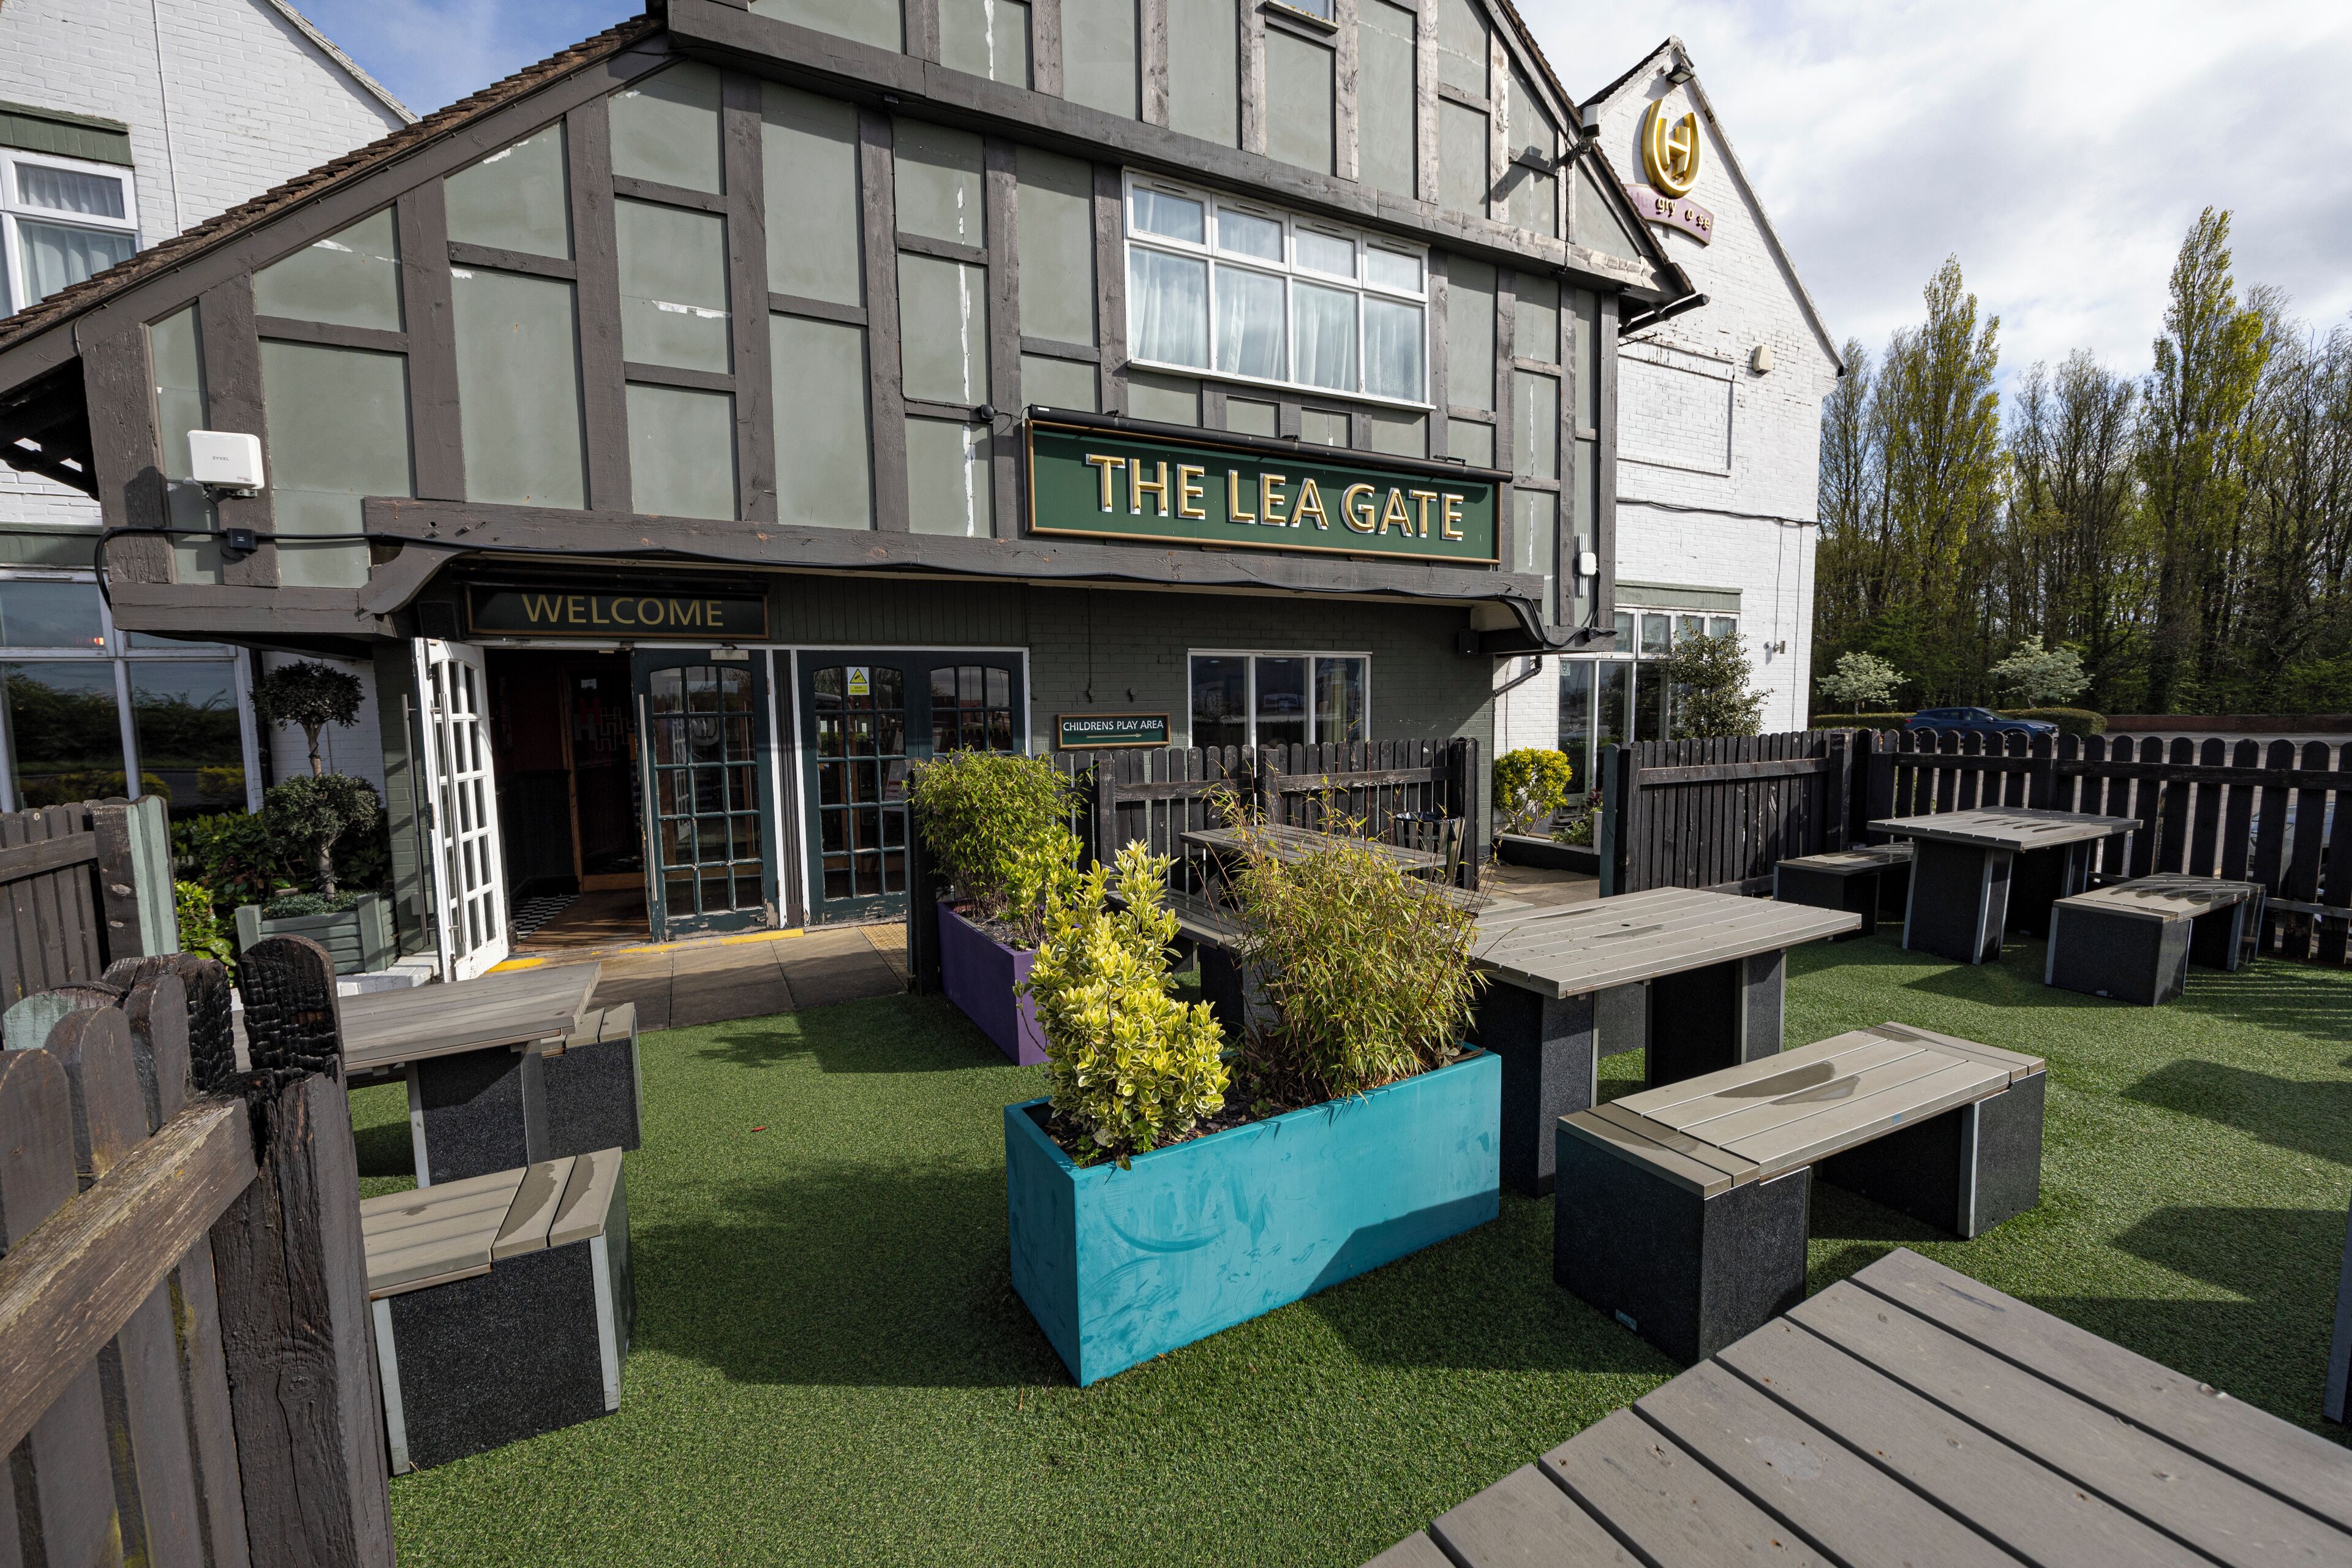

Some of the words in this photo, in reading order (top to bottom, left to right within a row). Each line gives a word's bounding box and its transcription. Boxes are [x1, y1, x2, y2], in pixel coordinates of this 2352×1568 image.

[1086, 453, 1205, 521] THE
[1227, 469, 1329, 530] LEA
[1340, 483, 1464, 541] GATE
[521, 594, 723, 627] WELCOME
[1063, 721, 1114, 731] CHILDRENS
[1117, 720, 1138, 729] PLAY
[1140, 720, 1164, 729] AREA
